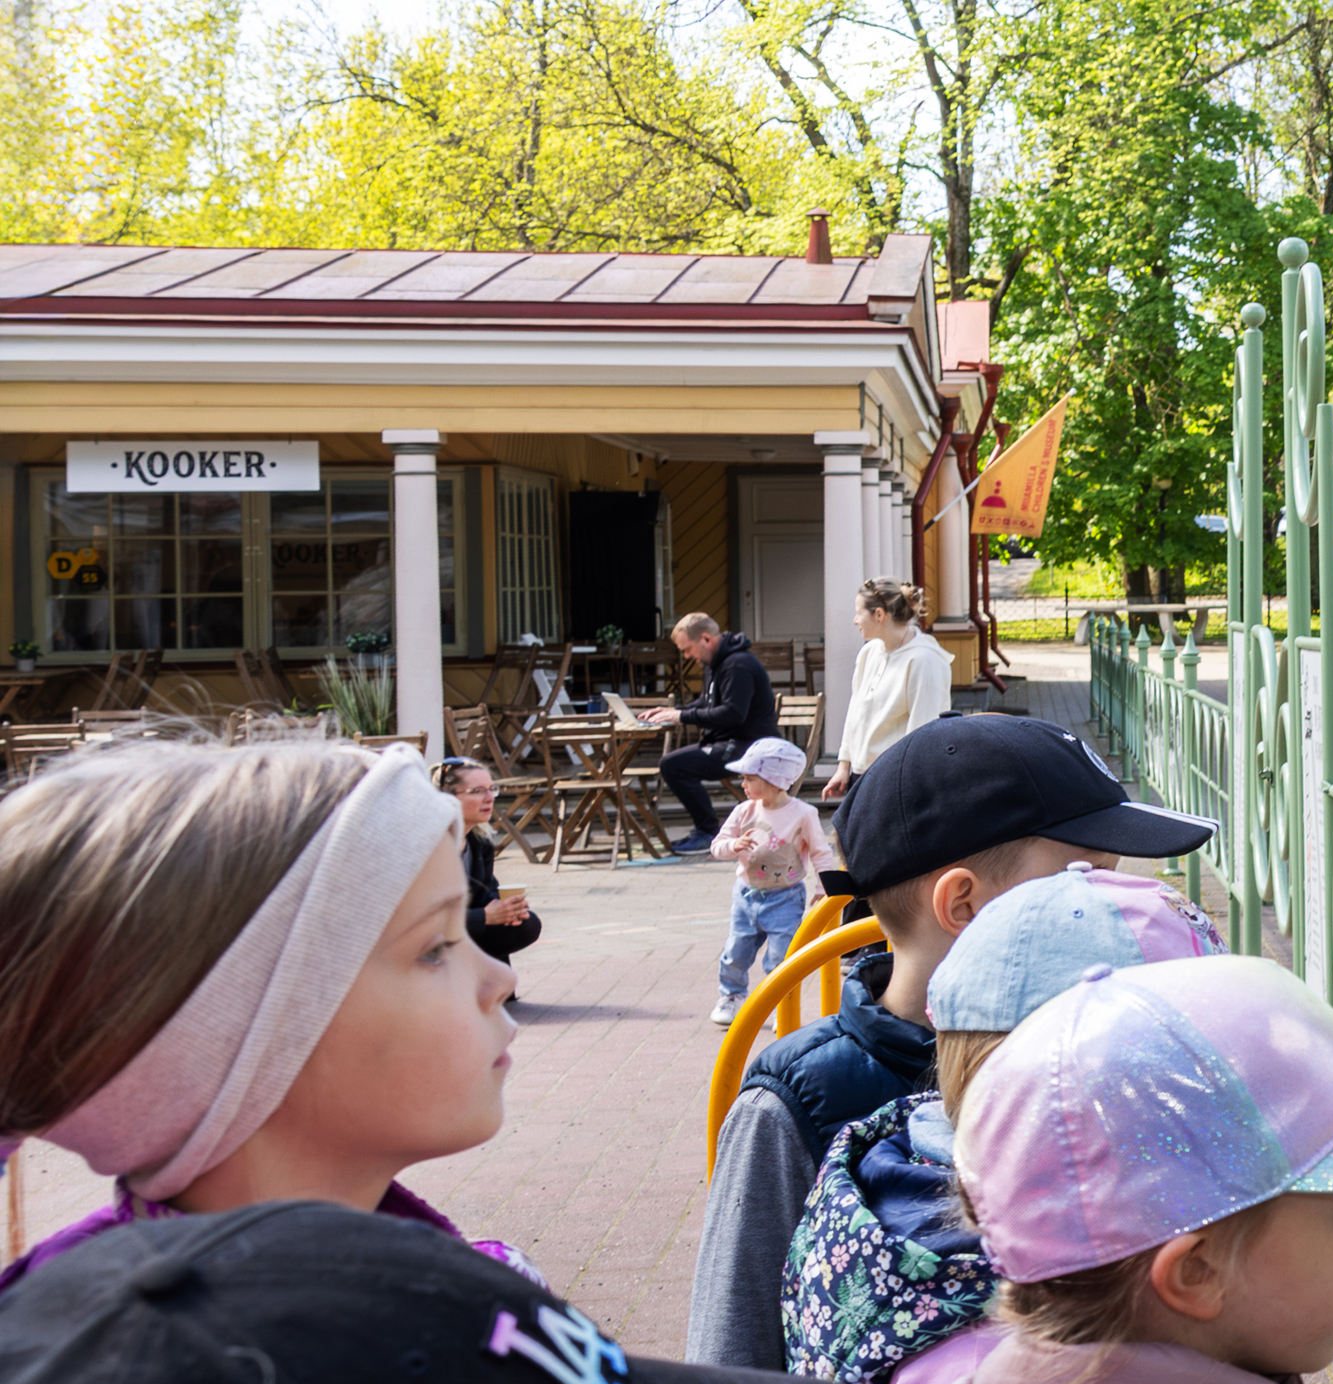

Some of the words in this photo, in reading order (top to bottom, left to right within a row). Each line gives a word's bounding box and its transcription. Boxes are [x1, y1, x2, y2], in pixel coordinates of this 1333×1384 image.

[1042, 419, 1056, 460] MUSEUM
[124, 450, 266, 486] KOOKER
[56, 558, 72, 573] D
